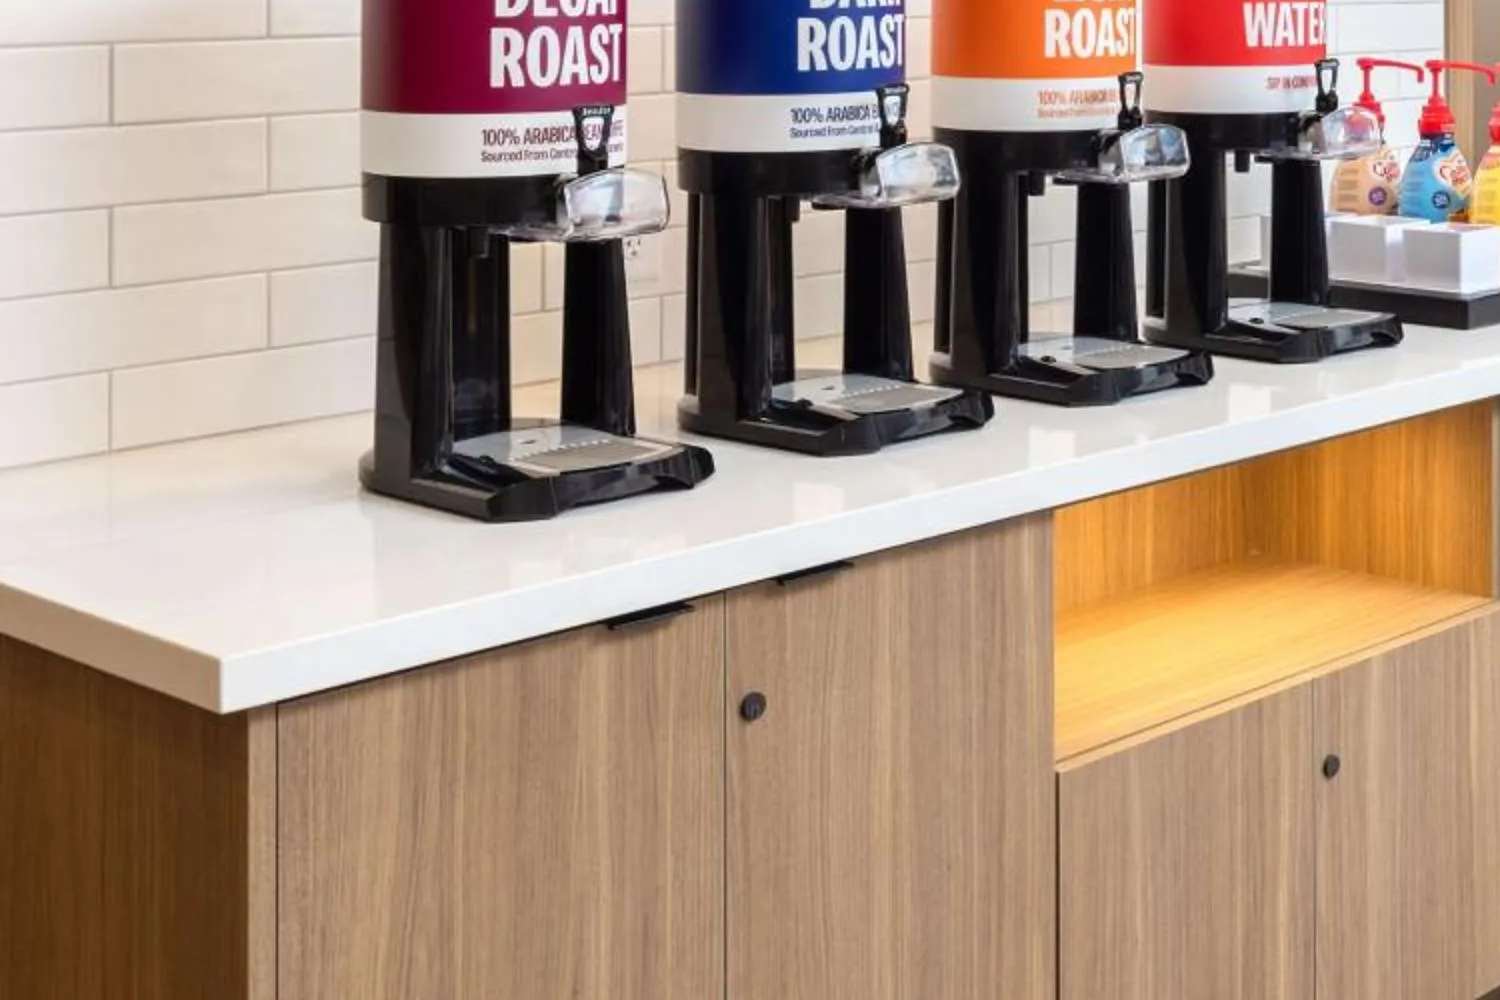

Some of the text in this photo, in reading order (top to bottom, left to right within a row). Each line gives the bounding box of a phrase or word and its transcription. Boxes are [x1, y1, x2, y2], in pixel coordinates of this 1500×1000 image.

[798, 13, 904, 71] ROAST
[1044, 7, 1135, 59] ROAST
[490, 23, 623, 88] ROAST
[791, 107, 824, 123] 100%
[482, 128, 520, 146] 100%
[523, 125, 577, 145] ARABICA
[551, 148, 577, 160] Centr
